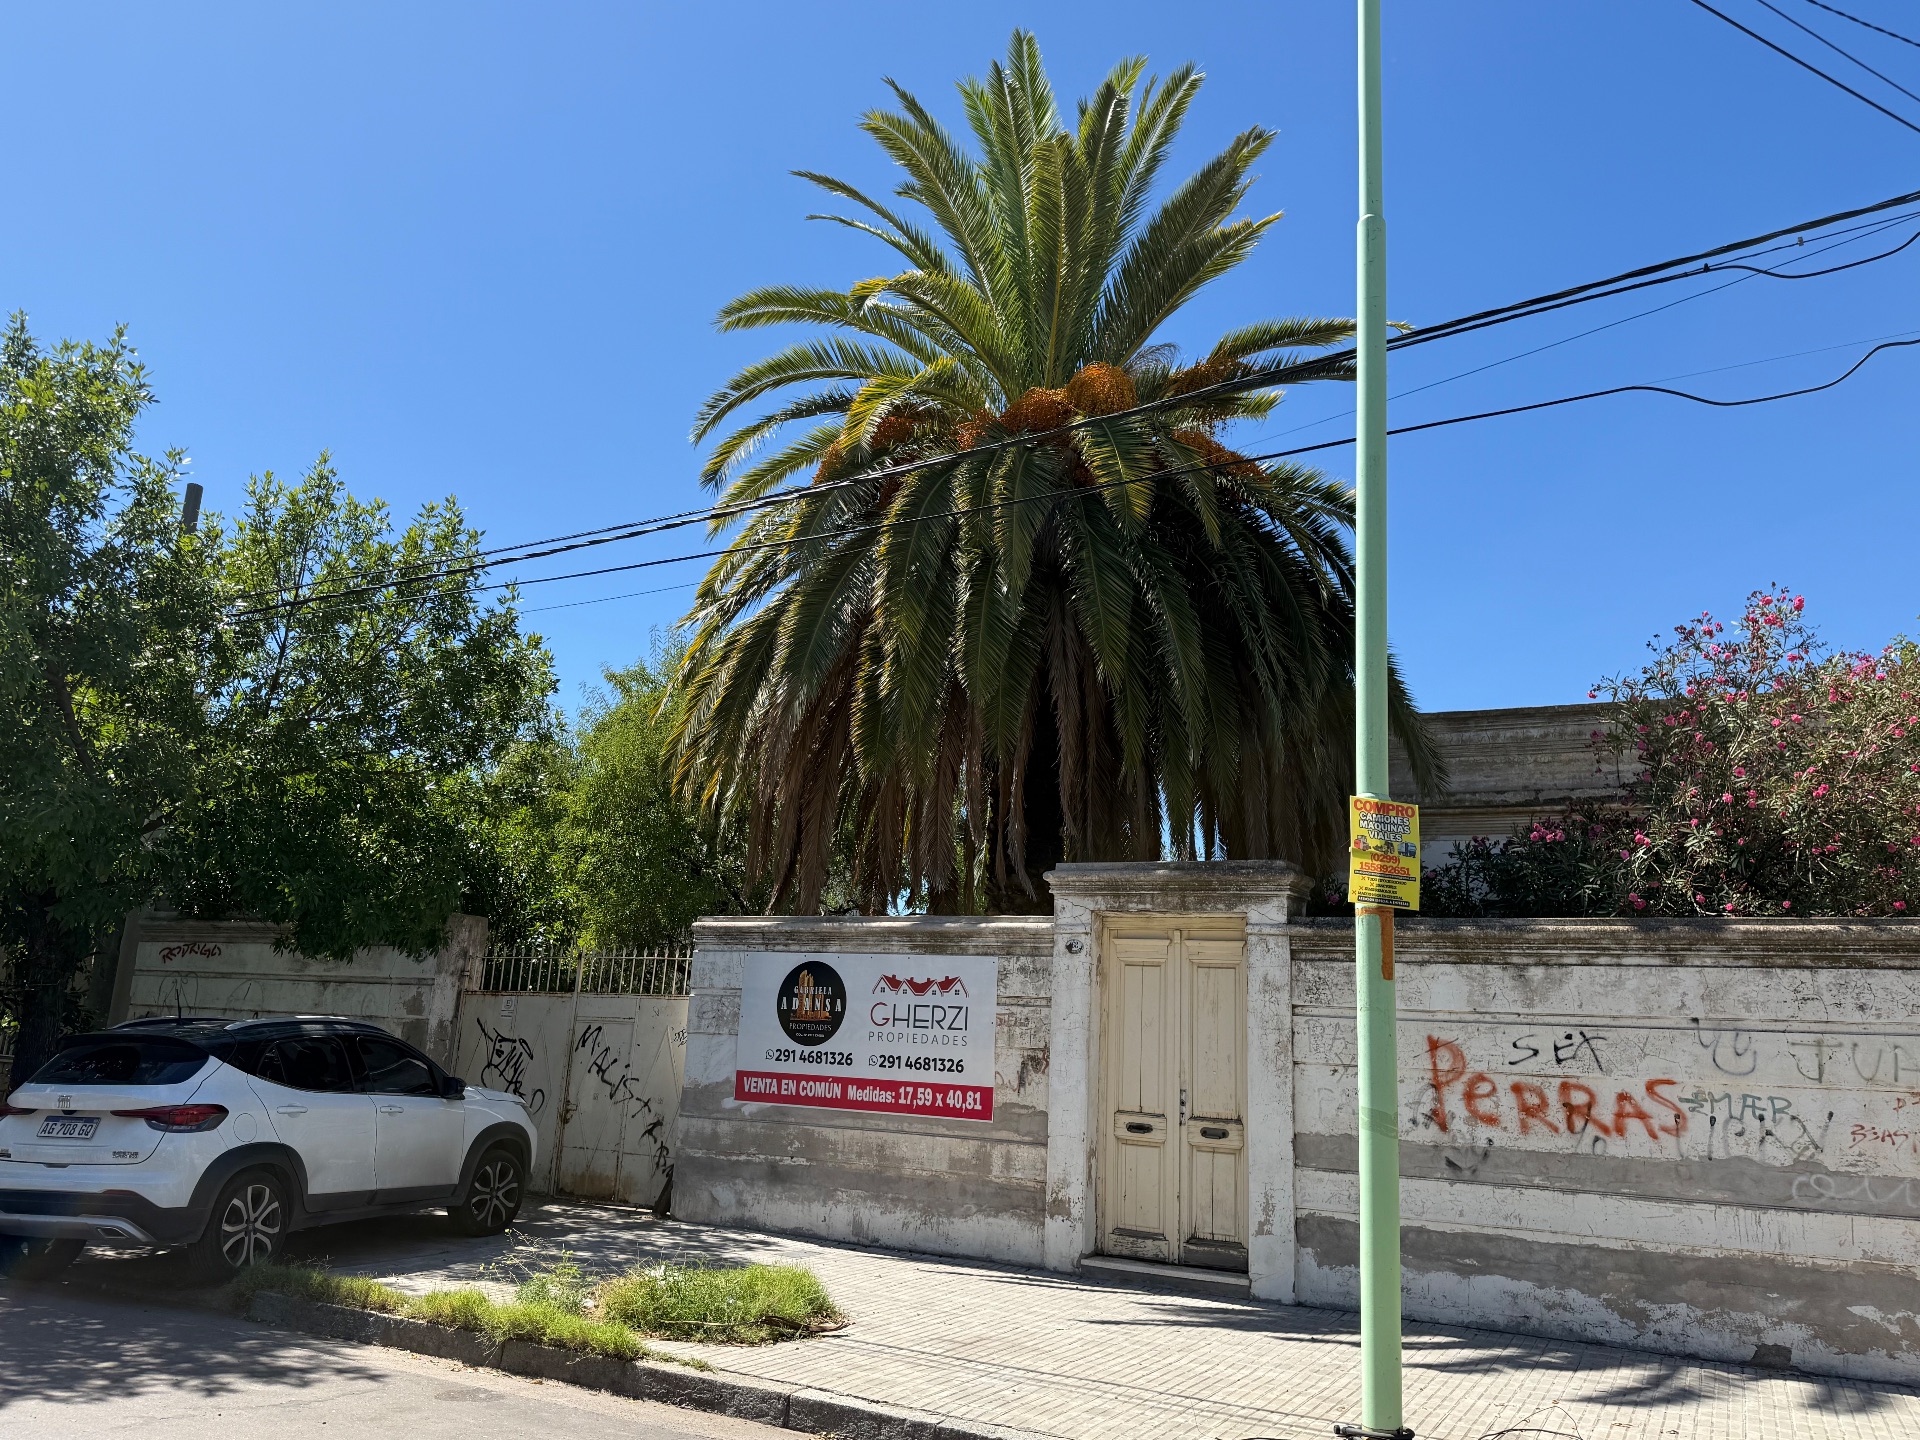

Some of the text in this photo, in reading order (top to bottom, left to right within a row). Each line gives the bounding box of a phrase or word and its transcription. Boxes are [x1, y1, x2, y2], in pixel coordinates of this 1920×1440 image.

[1353, 799, 1416, 818] COMPRO
[1359, 811, 1410, 825] CAMIONES
[1368, 830, 1403, 842] VIALES
[1370, 853, 1400, 866] (0299)
[1359, 862, 1411, 876] 155892651
[793, 985, 832, 995] GABRIELA
[780, 996, 842, 1012] ADANSA
[870, 1002, 969, 1031] GHERZI
[789, 1022, 832, 1032] PROPIEDADES
[868, 1031, 968, 1047] PROPIEDADES
[774, 1048, 853, 1066] 291 4681326
[878, 1054, 964, 1073] 291 4681326
[743, 1076, 982, 1113] VENTA EN COMÚN Medidas: 17,59 x 40,81
[40, 1122, 57, 1135] AG
[56, 1123, 78, 1136] 708
